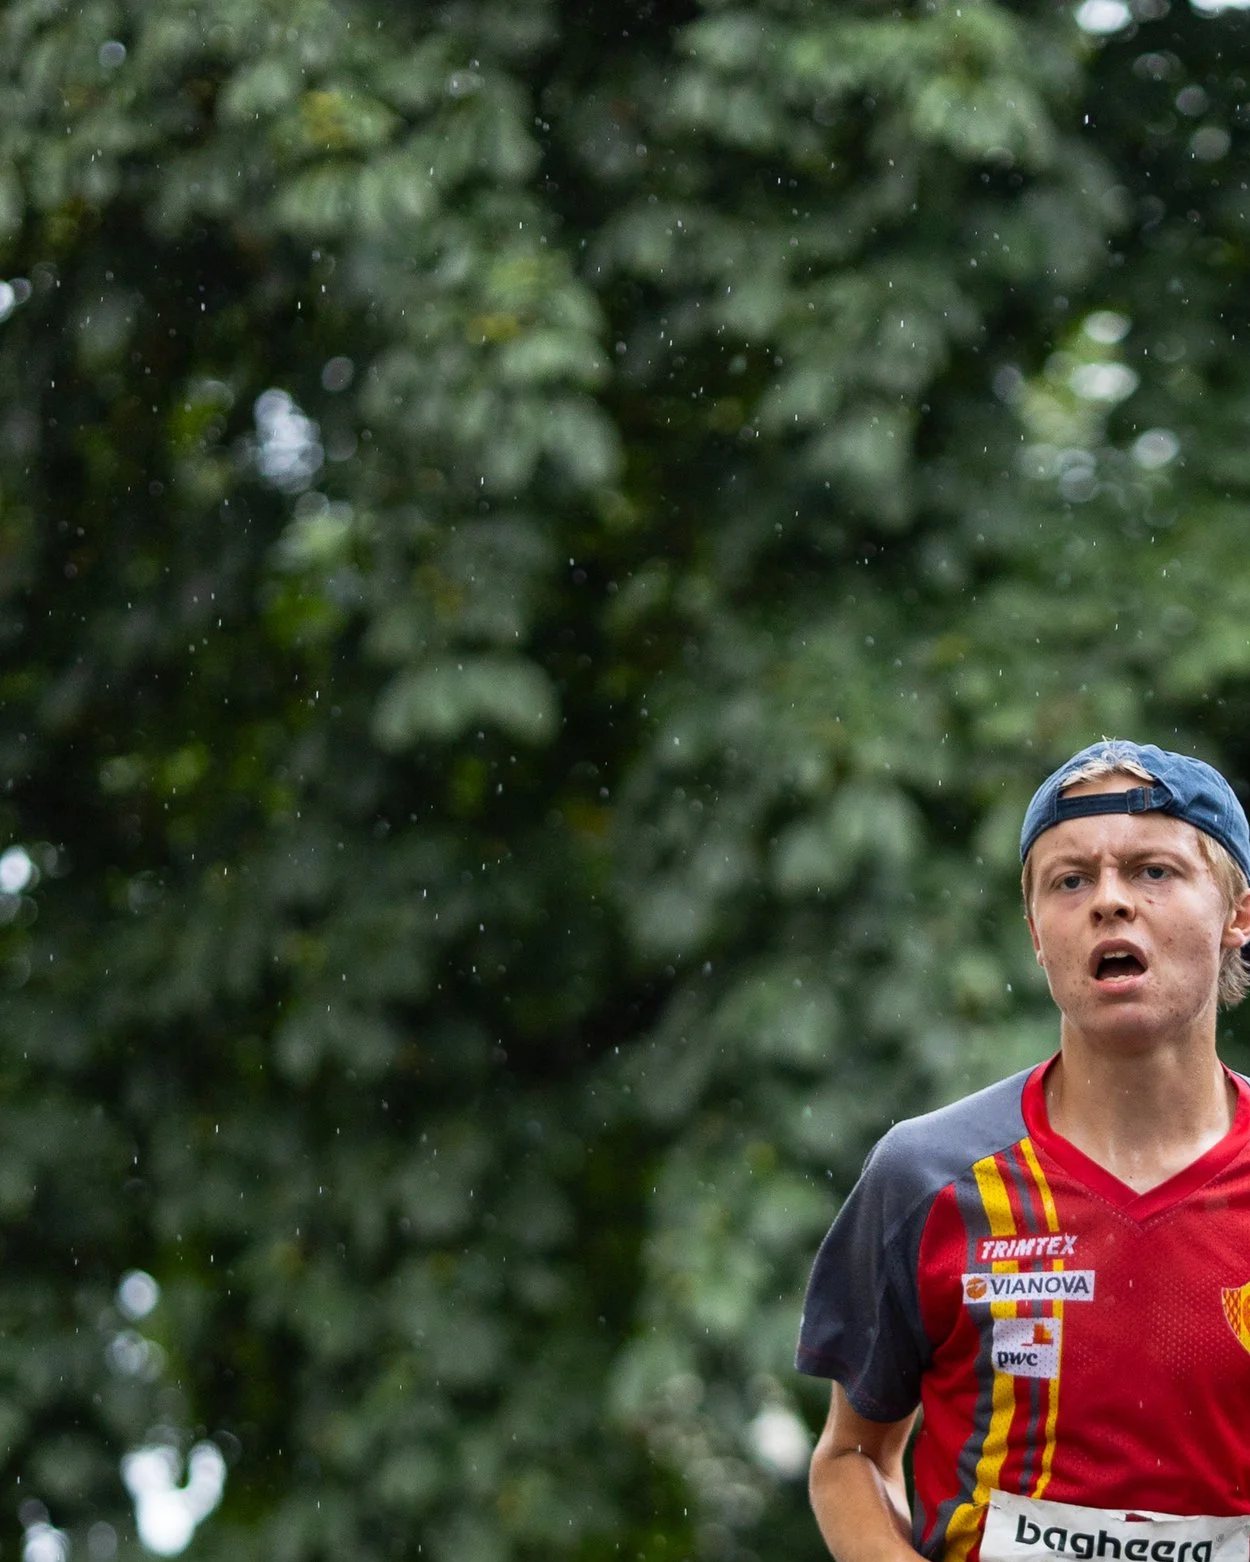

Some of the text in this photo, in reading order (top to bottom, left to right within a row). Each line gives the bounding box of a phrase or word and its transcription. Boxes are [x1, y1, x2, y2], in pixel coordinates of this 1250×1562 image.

[981, 1233, 1078, 1260] TRIMTEX
[990, 1275, 1090, 1295] VIANOVA
[996, 1350, 1039, 1368] pwc
